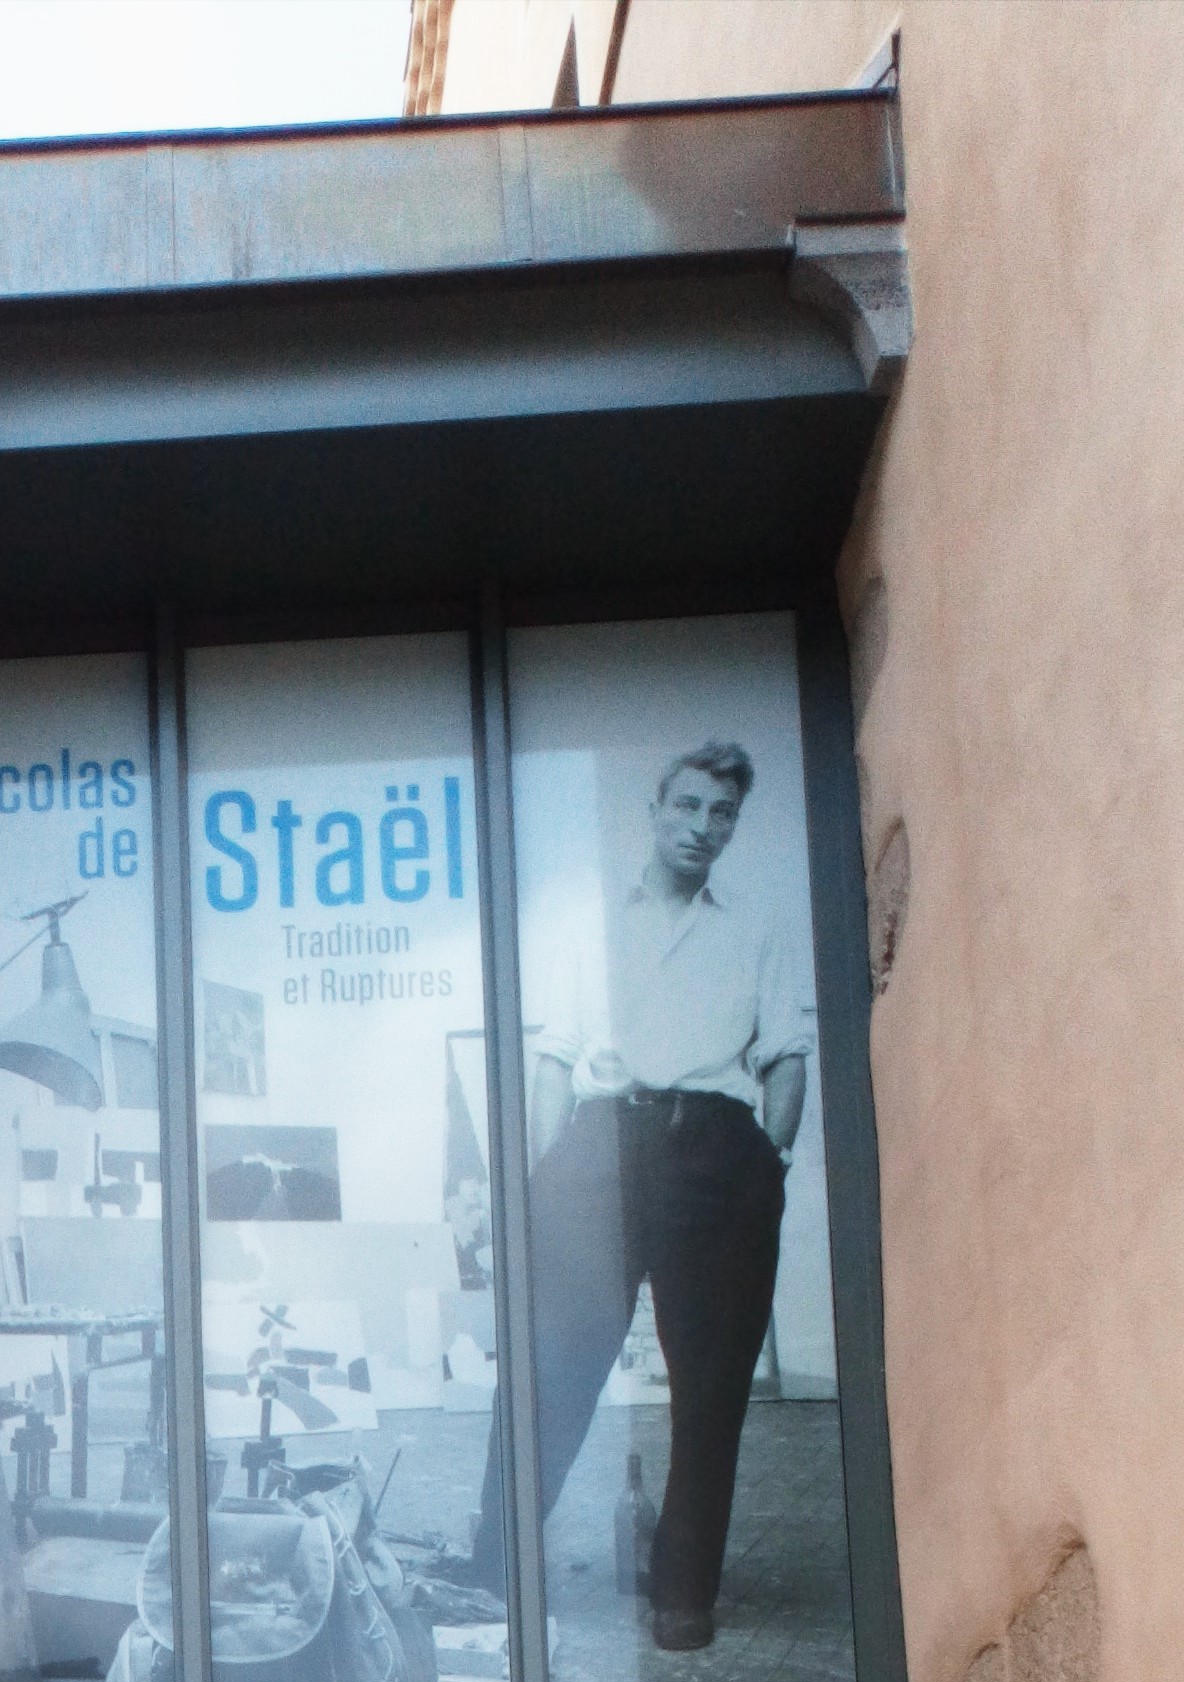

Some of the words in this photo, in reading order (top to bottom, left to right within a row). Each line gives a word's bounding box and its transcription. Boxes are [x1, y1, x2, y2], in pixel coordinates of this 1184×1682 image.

[78, 817, 138, 880] de
[203, 775, 464, 913] Staël
[282, 922, 411, 959] Tradition
[283, 969, 311, 1005] et
[321, 965, 453, 1007] Ruptures
